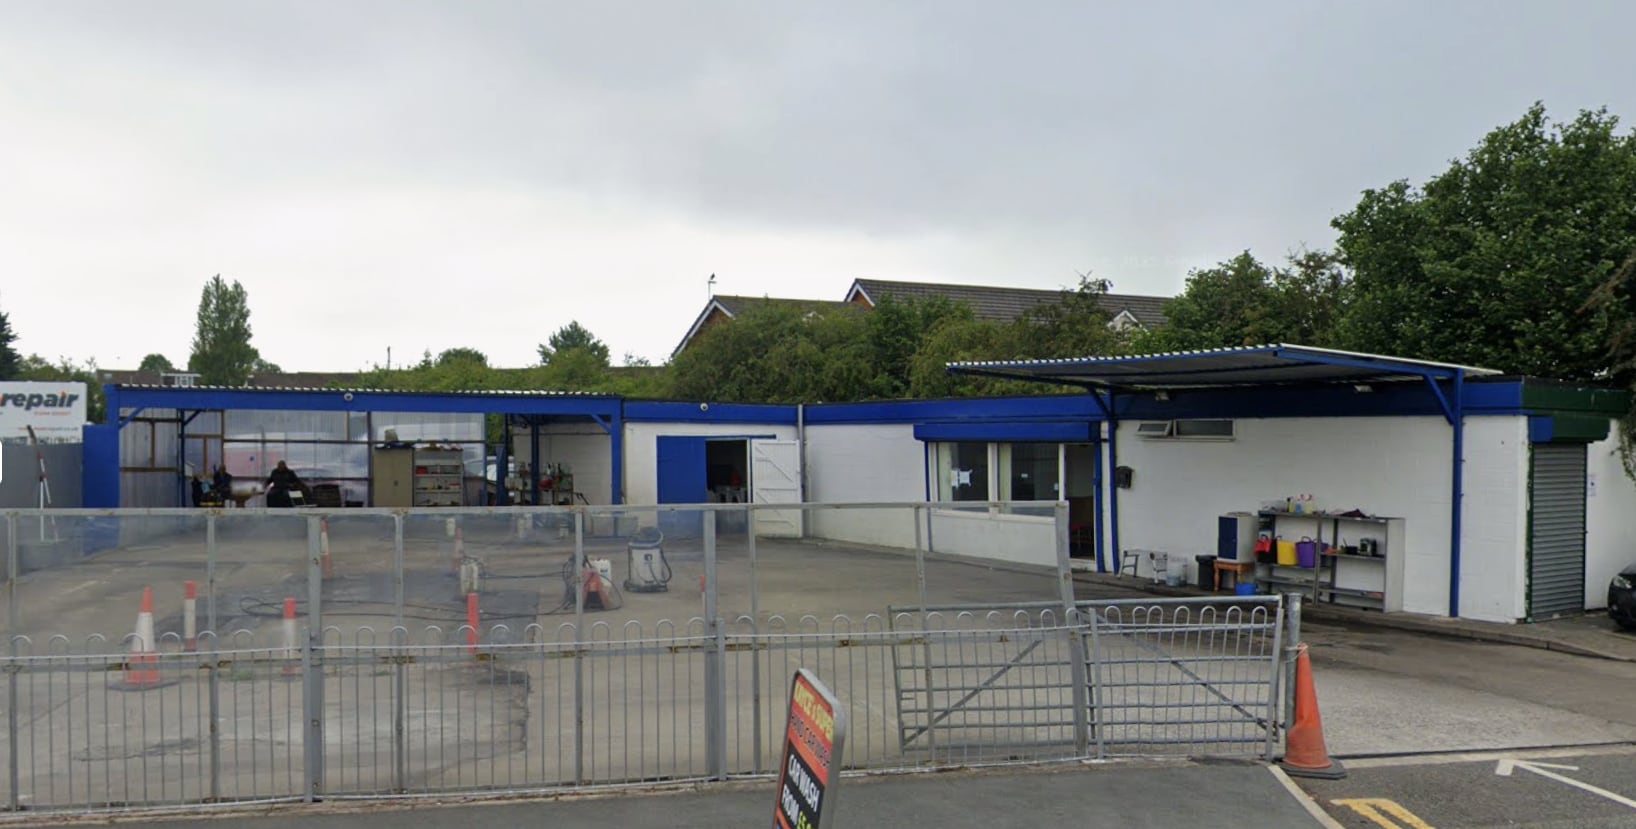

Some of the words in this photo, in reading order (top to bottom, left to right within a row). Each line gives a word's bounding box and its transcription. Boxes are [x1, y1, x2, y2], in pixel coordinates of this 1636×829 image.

[0, 391, 79, 411] repair
[788, 754, 800, 787] CAR
[799, 767, 820, 812] WASH
[781, 784, 799, 826] FROM
